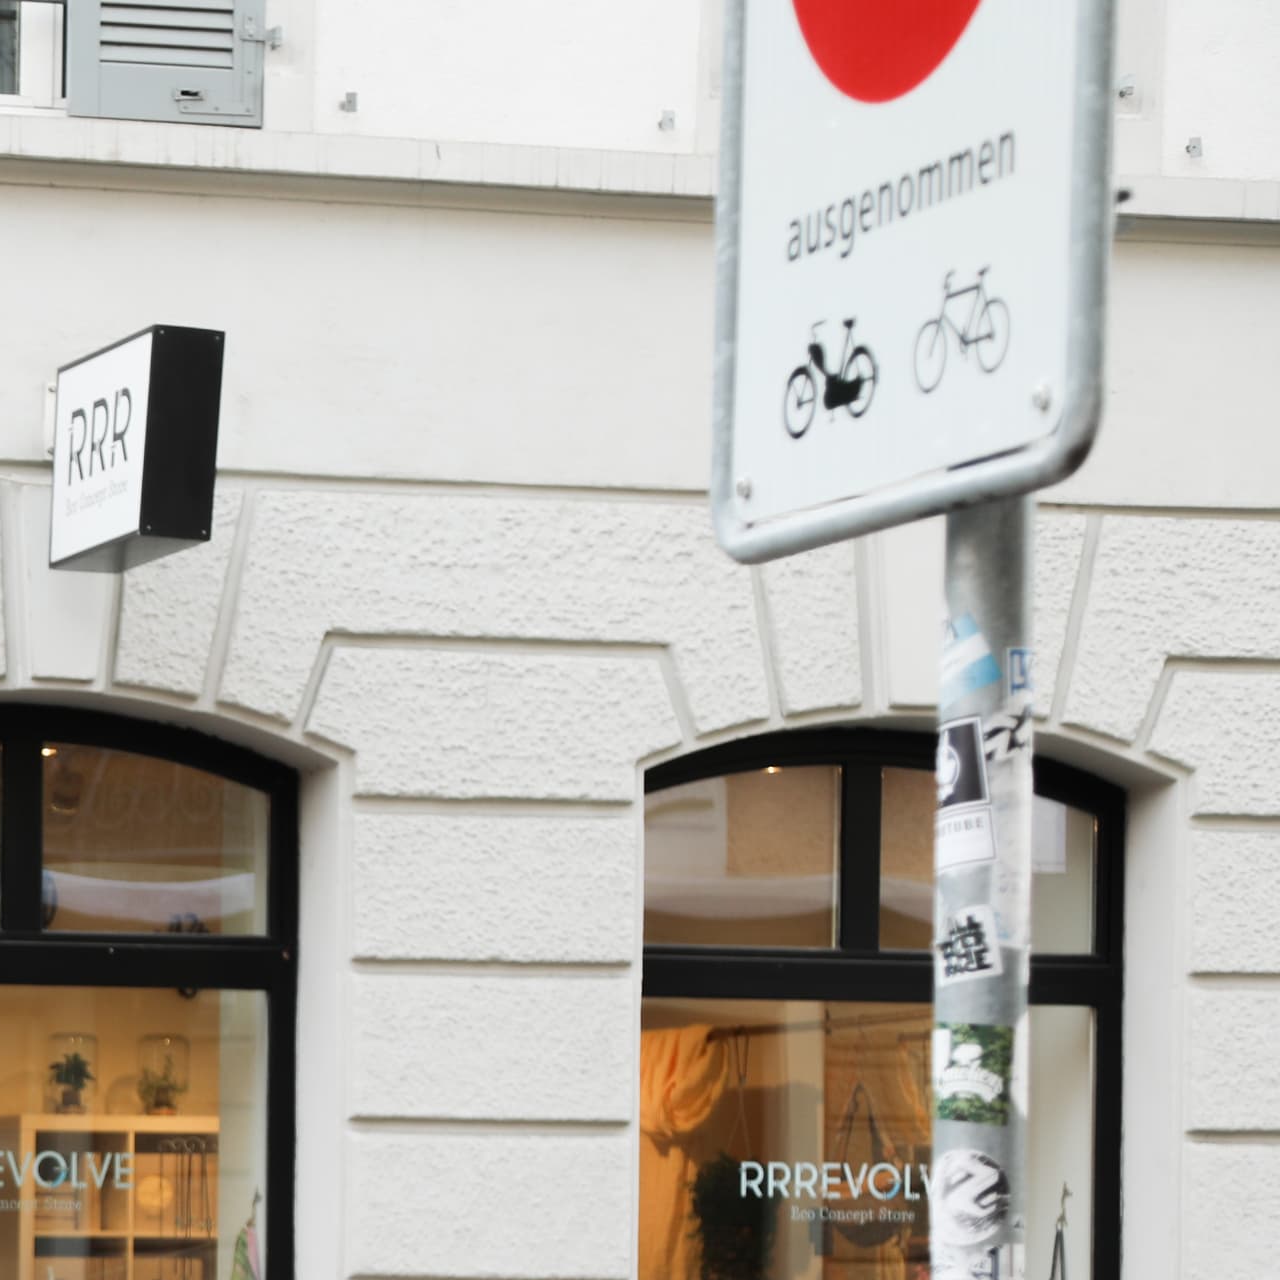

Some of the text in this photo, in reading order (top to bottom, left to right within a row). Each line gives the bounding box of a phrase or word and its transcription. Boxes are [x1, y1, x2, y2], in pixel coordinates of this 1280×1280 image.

[786, 130, 1016, 262] ausgenommen
[67, 387, 132, 486] RRR
[791, 1206, 916, 1225] Eco Concept Store
